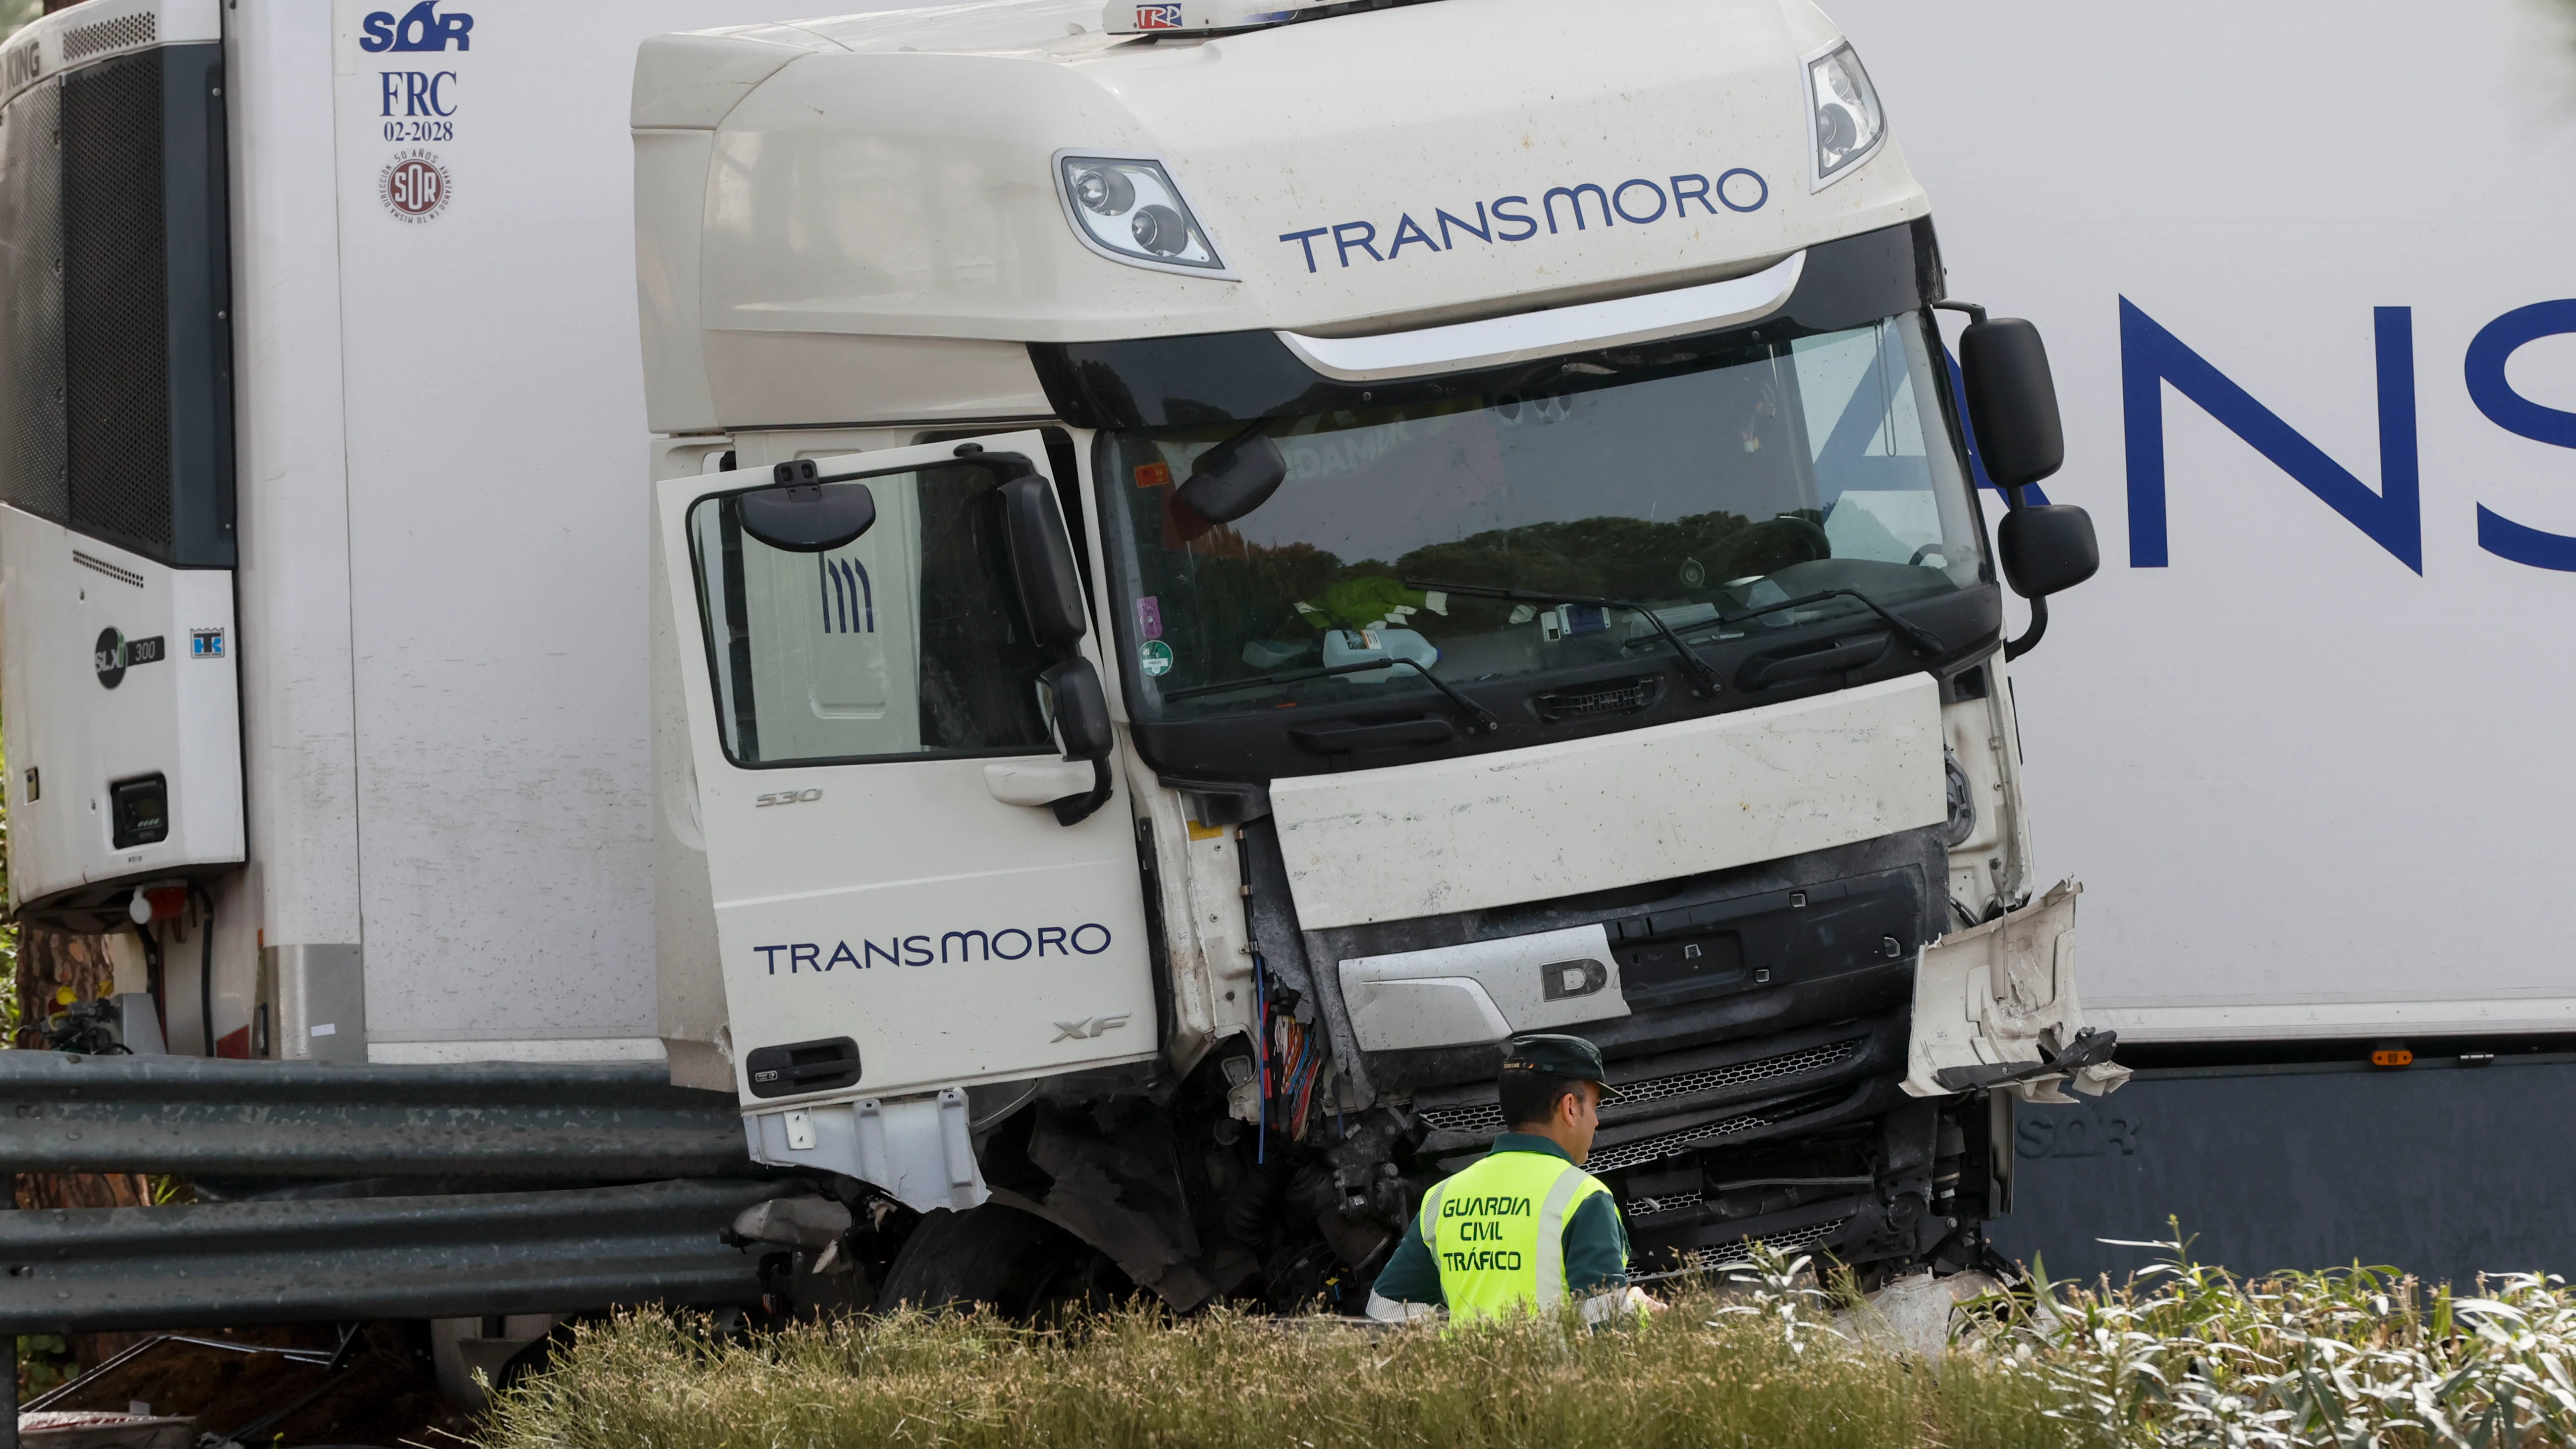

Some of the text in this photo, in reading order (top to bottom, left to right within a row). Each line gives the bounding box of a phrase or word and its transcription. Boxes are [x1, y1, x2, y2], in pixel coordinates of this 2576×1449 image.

[1136, 5, 1182, 28] TRP
[378, 71, 457, 116] FRC
[383, 121, 453, 141] 02-2028
[394, 151, 407, 162] 50
[395, 164, 436, 210] SOR
[1280, 168, 1768, 273] TRANSMORO
[135, 641, 156, 661] 300
[755, 789, 822, 807] 530
[753, 923, 1111, 975] TRANSMORO
[1050, 1012, 1131, 1043] XF
[1443, 1197, 1530, 1218] GUARDIA
[1460, 1221, 1503, 1241] CIVIL
[1443, 1247, 1521, 1272] TRÁFICO
